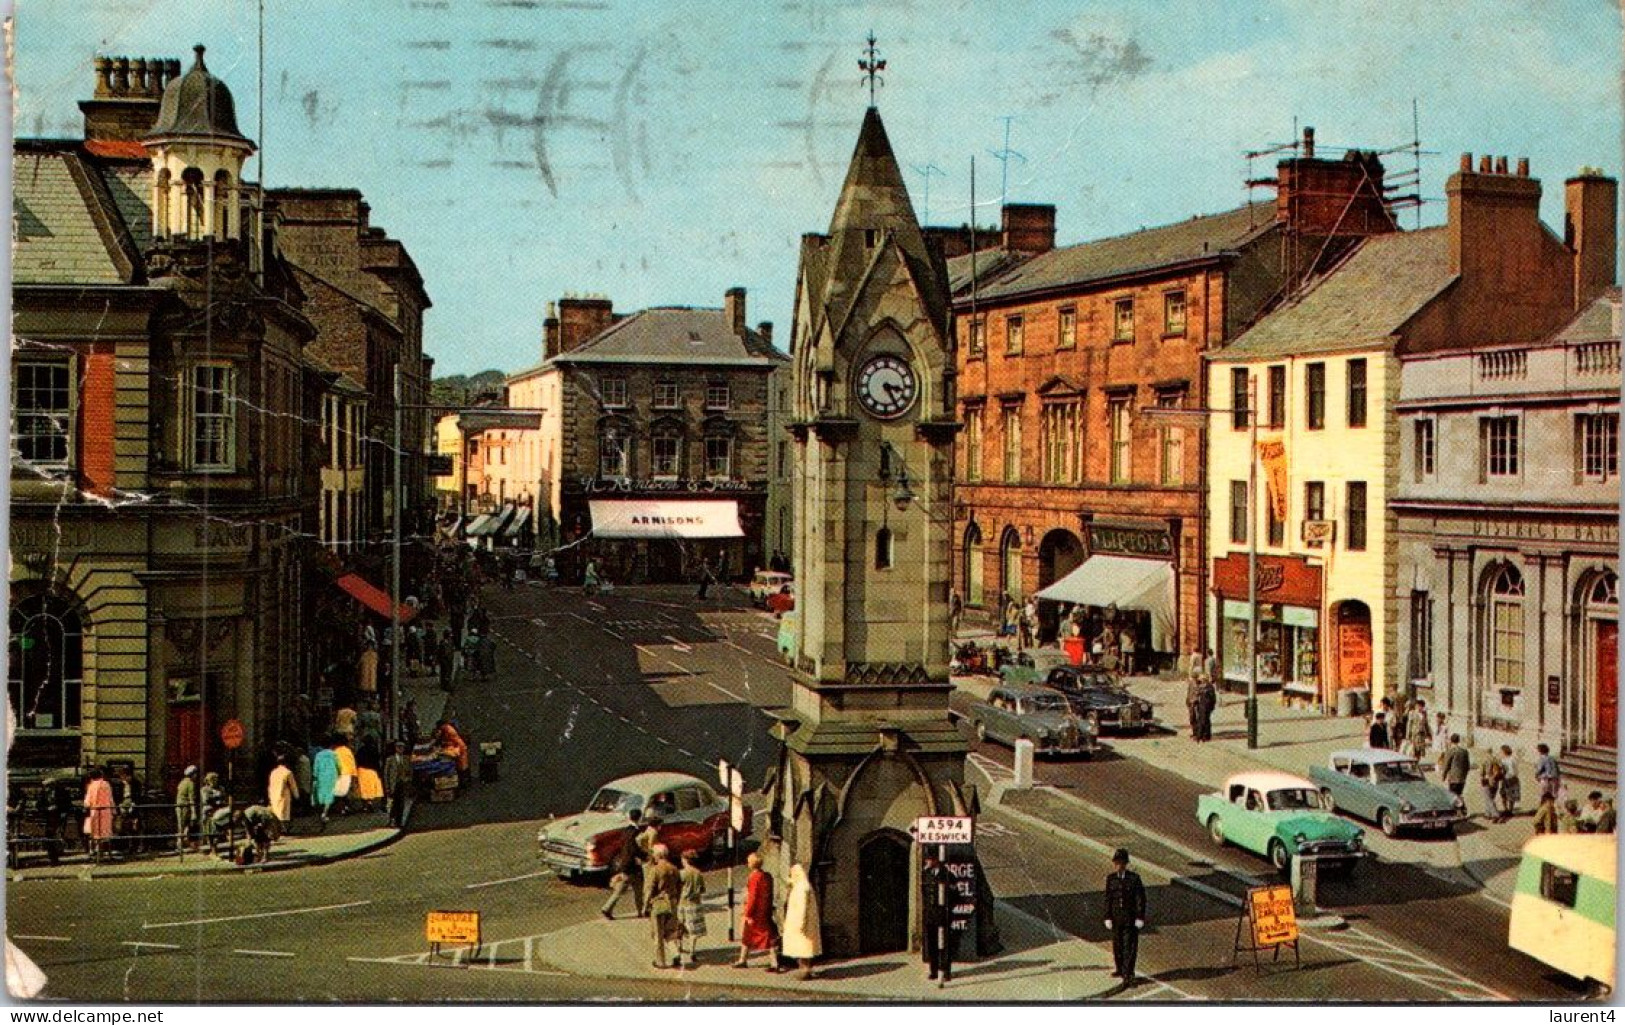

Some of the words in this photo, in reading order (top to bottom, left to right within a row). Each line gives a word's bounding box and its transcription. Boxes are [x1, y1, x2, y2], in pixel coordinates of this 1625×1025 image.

[631, 516, 704, 525] ARNISONS
[1472, 519, 1558, 539] DISTRICT
[927, 819, 964, 830] A594
[920, 832, 969, 841] KESWICK
